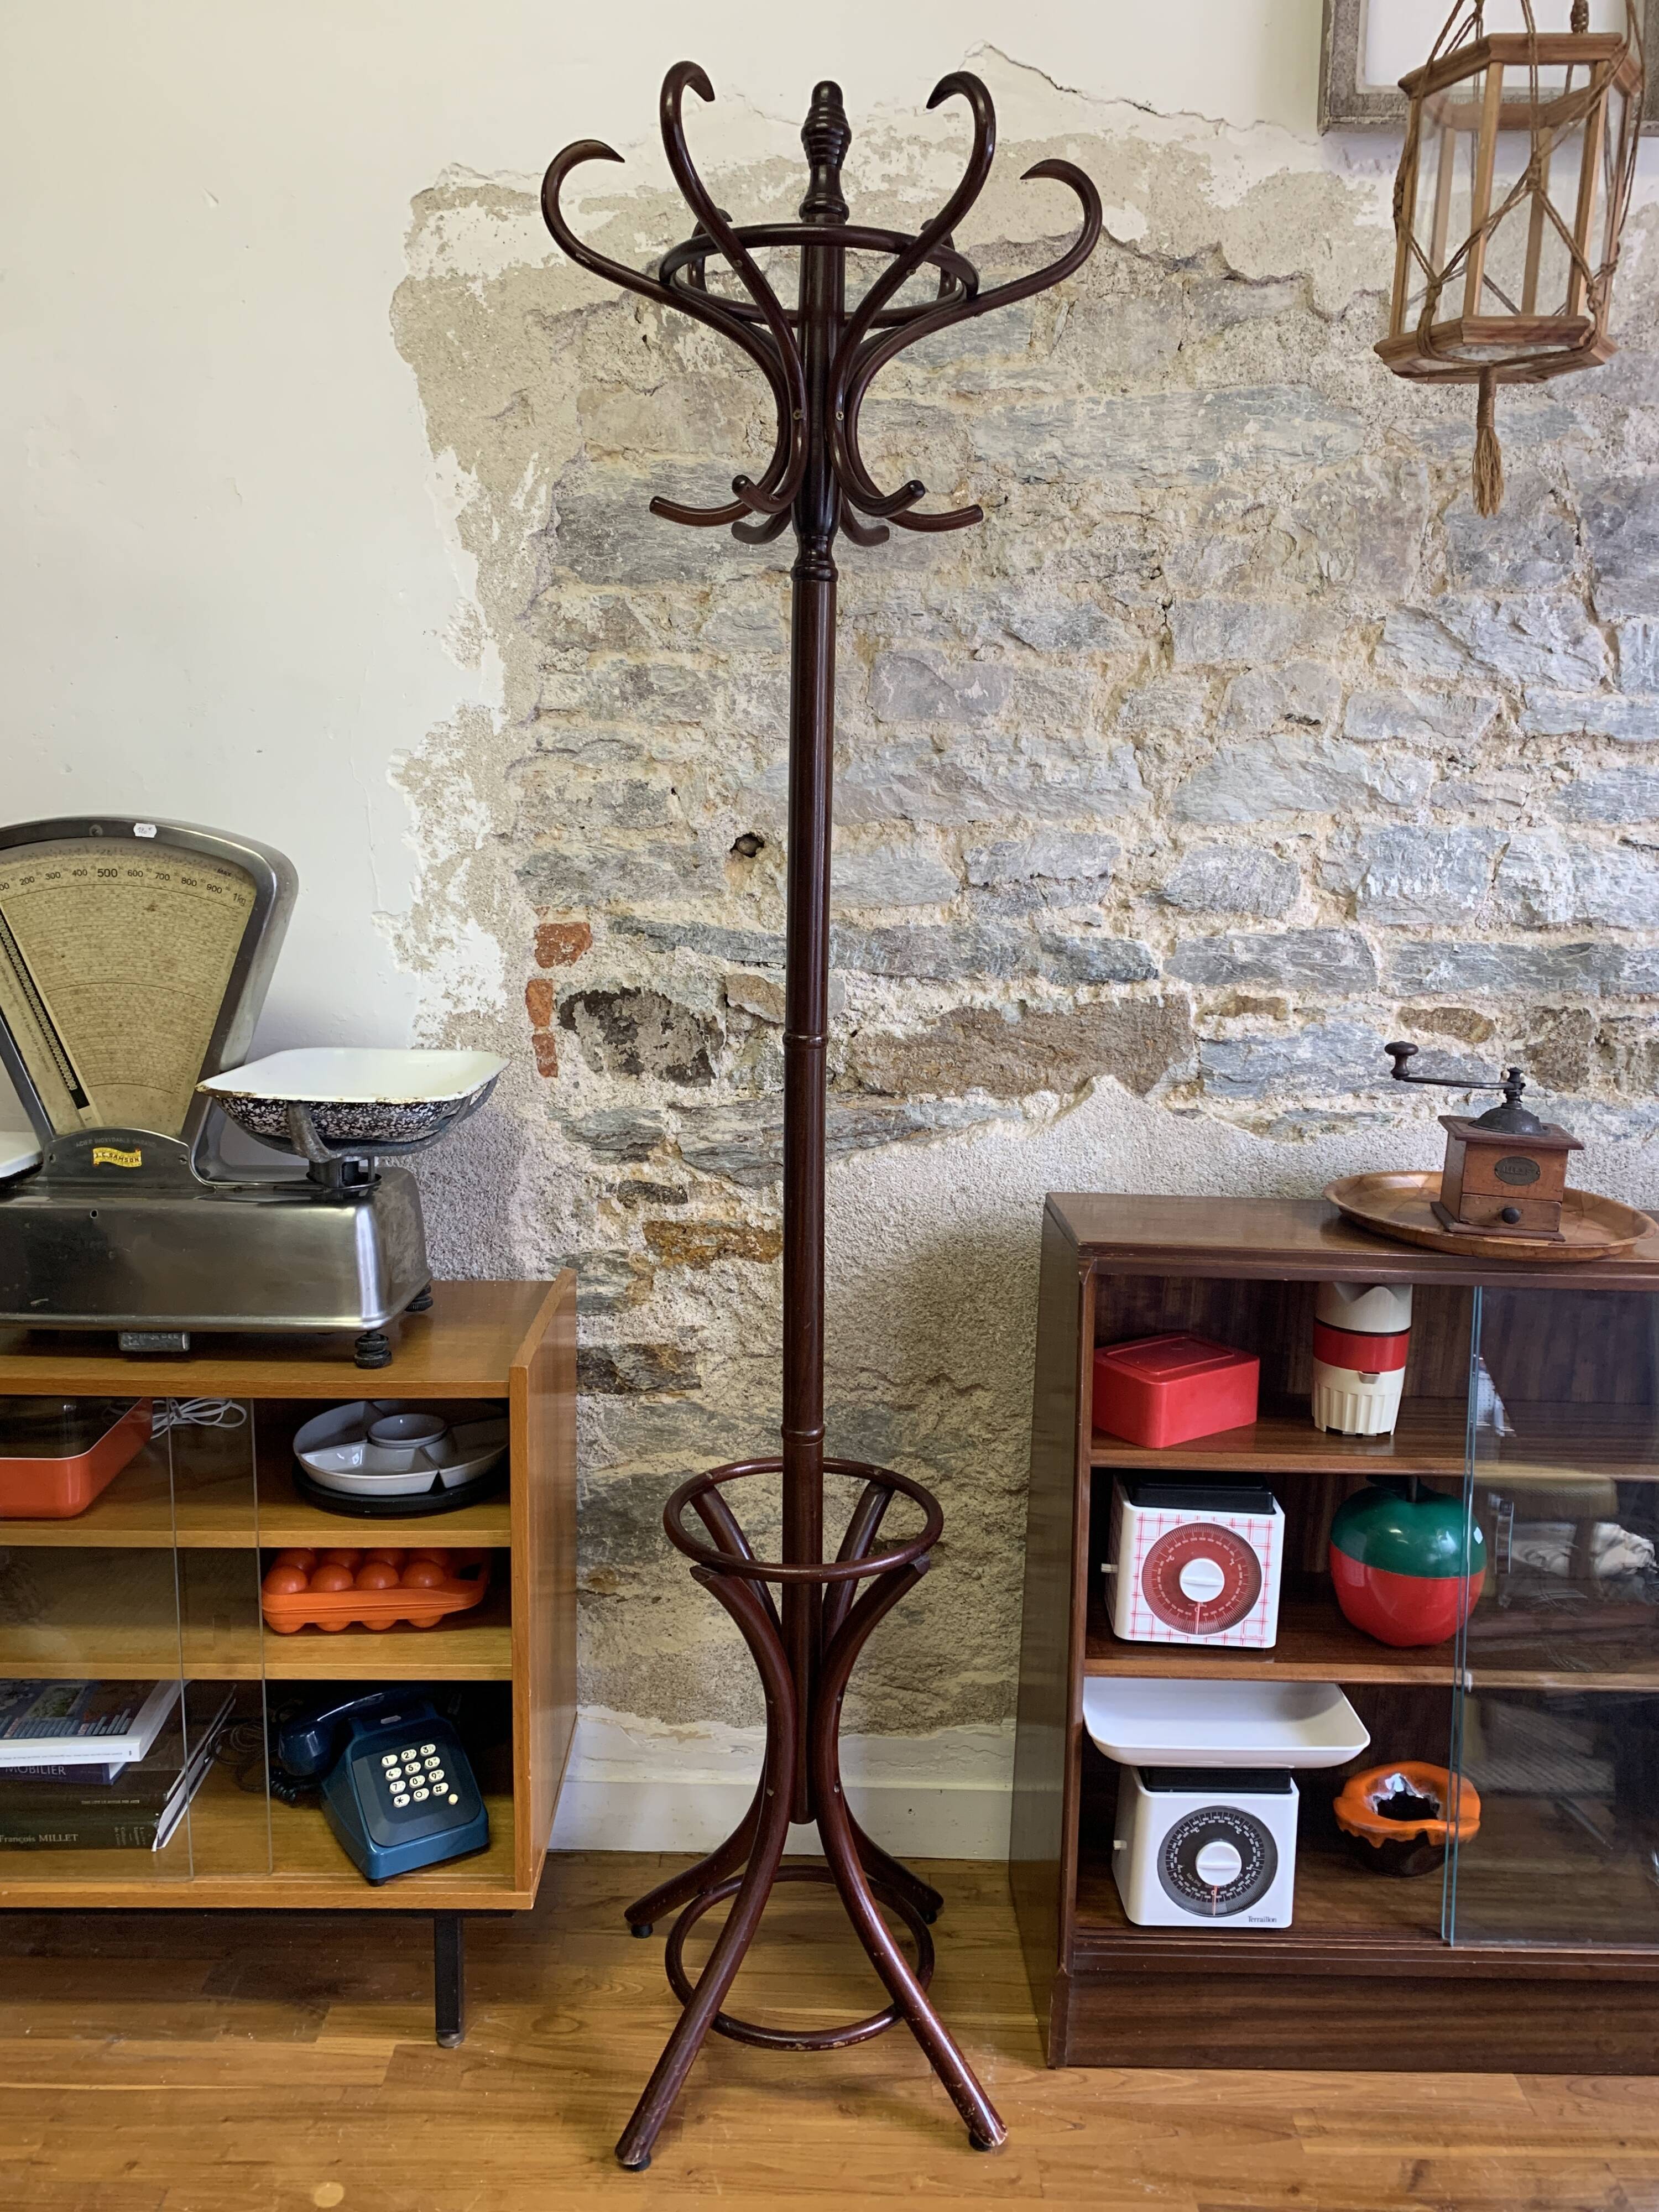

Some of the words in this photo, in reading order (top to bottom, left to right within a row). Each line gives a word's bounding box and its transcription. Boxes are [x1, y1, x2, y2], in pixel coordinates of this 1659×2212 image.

[217, 868, 232, 877] MAX
[0, 882, 10, 891] 00
[19, 876, 35, 885] 200
[45, 872, 61, 880] 300
[97, 868, 118, 877] 500
[127, 869, 143, 878] 600
[155, 872, 170, 881] 700
[181, 877, 197, 887] 800
[206, 884, 222, 894] 900
[233, 893, 247, 906] 1kg
[5, 1766, 66, 1776] MOBILIER
[39, 1834, 79, 1842] MILLET
